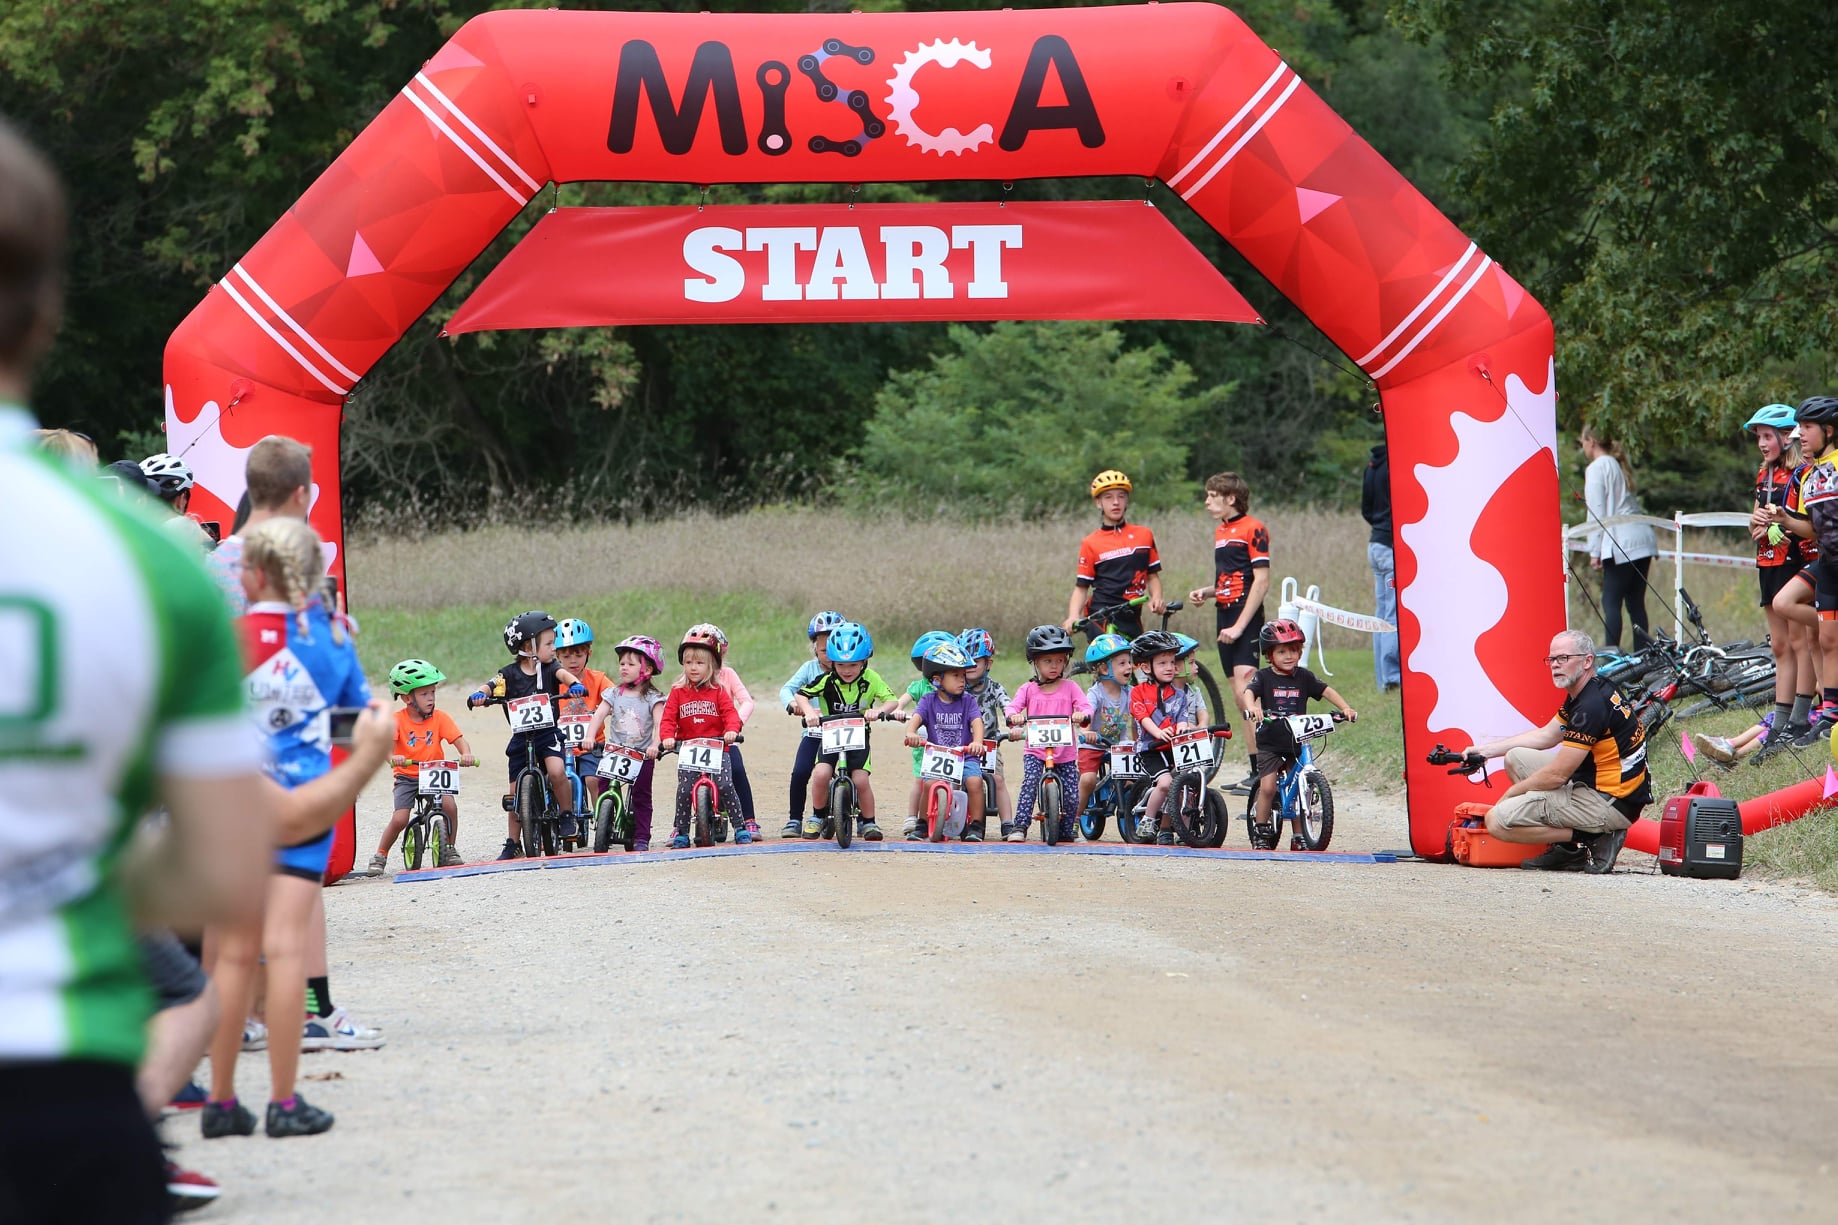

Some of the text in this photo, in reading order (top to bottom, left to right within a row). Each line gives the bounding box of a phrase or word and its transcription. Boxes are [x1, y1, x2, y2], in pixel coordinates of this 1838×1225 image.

[682, 224, 1024, 303] START
[520, 705, 544, 725] 23
[1300, 715, 1324, 733] 25
[563, 724, 585, 741] 19
[832, 727, 855, 746] 17
[1038, 729, 1062, 743] 30
[689, 747, 711, 767] 14
[1180, 742, 1201, 764] 21
[610, 755, 632, 777] 13
[930, 756, 955, 776] 26
[1122, 755, 1141, 773] 18
[429, 770, 451, 788] 20
